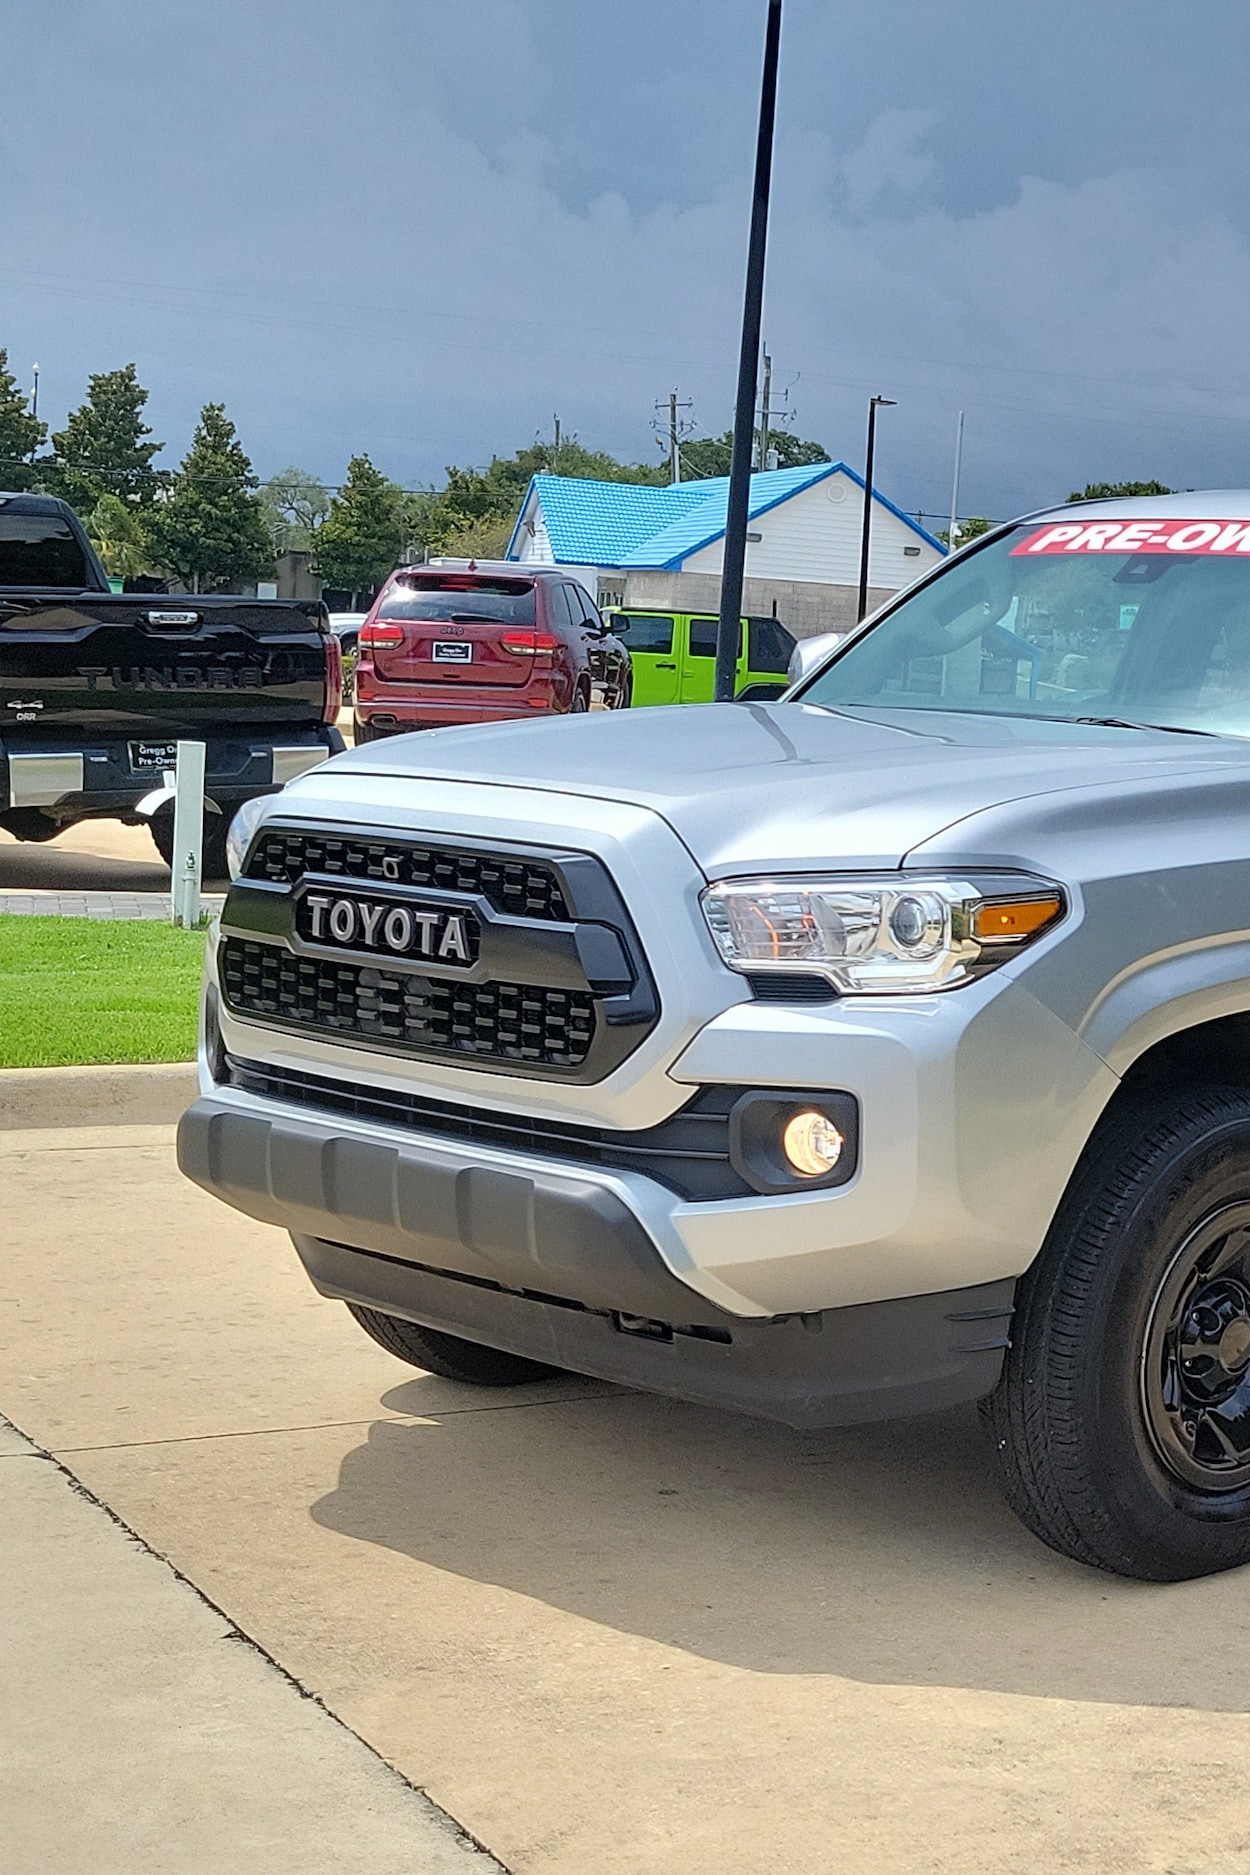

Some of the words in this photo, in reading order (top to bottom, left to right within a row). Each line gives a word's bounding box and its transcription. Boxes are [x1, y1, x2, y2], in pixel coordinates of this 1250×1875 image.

[76, 667, 264, 693] TUNDRA
[138, 757, 177, 765] Pre-Own
[307, 896, 472, 961] TOYOTA
